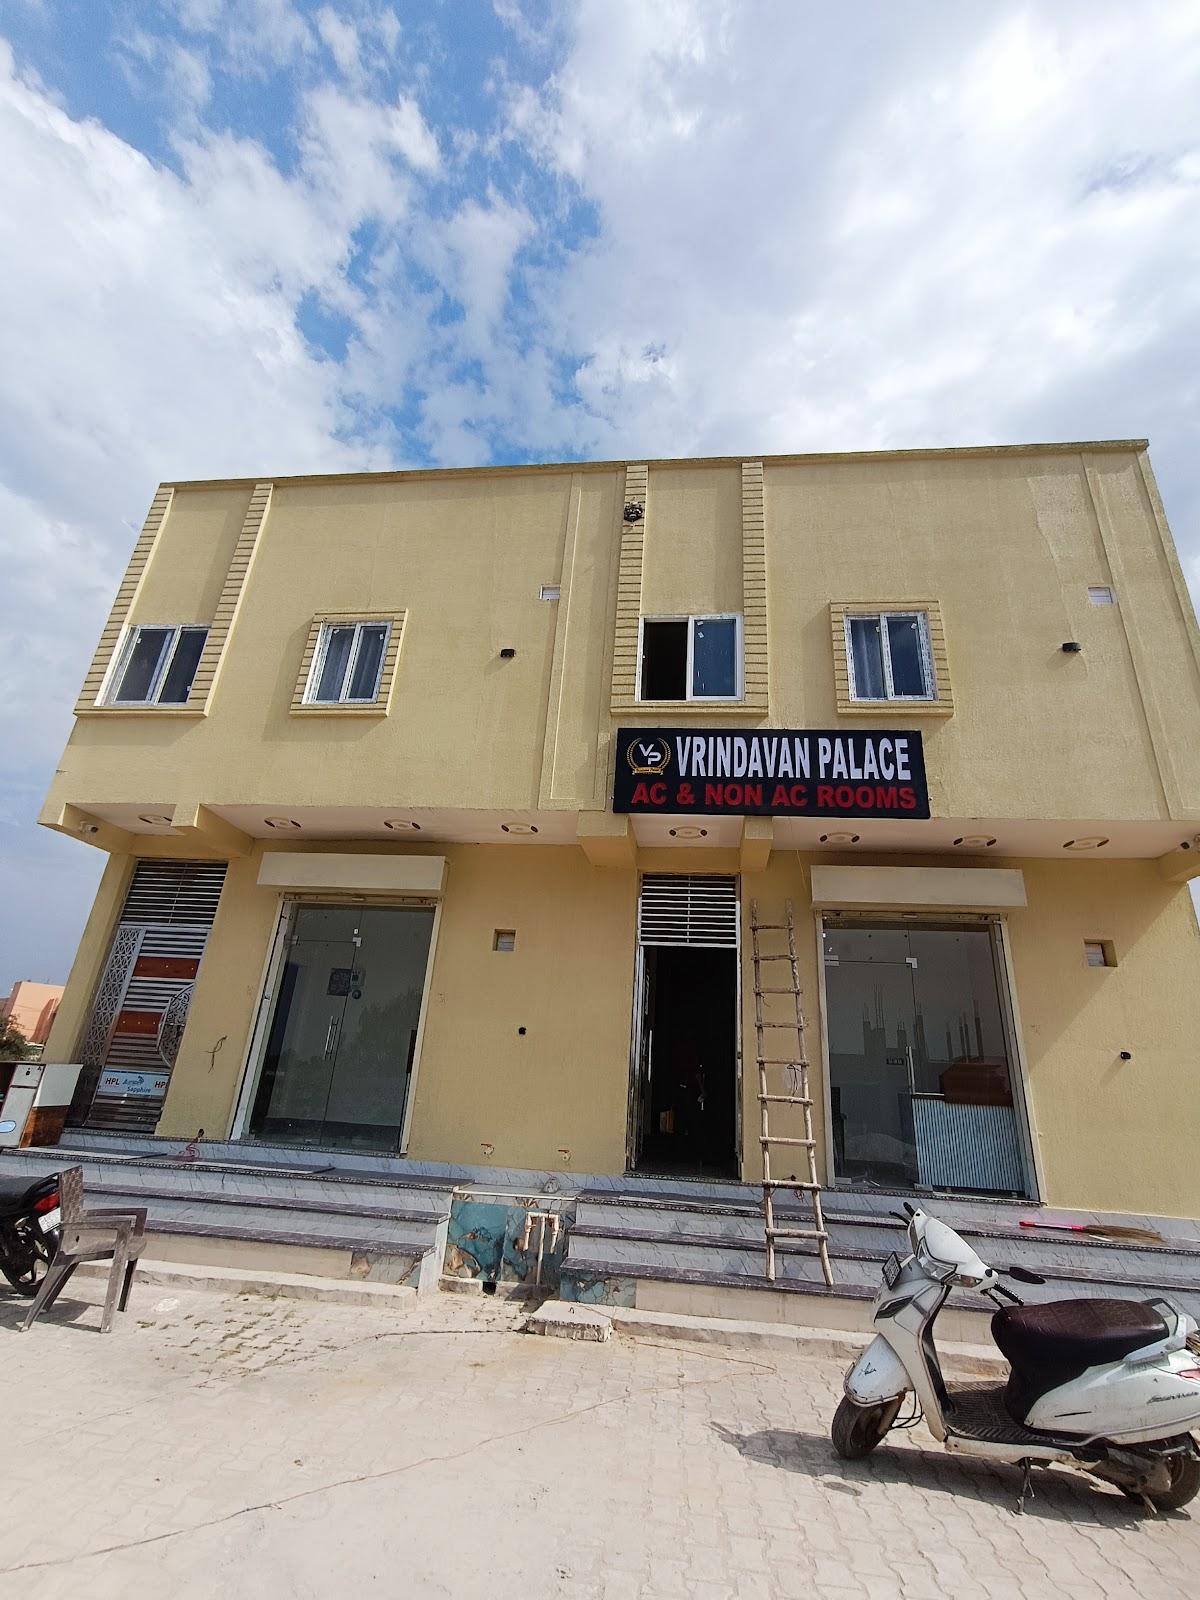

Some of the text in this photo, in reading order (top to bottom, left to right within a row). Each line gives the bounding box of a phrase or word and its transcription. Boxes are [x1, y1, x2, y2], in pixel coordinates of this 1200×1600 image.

[638, 743, 662, 766] VP
[675, 736, 912, 781] VRINDAVAN PALACE
[631, 782, 917, 810] AC & NON AC ROOMS
